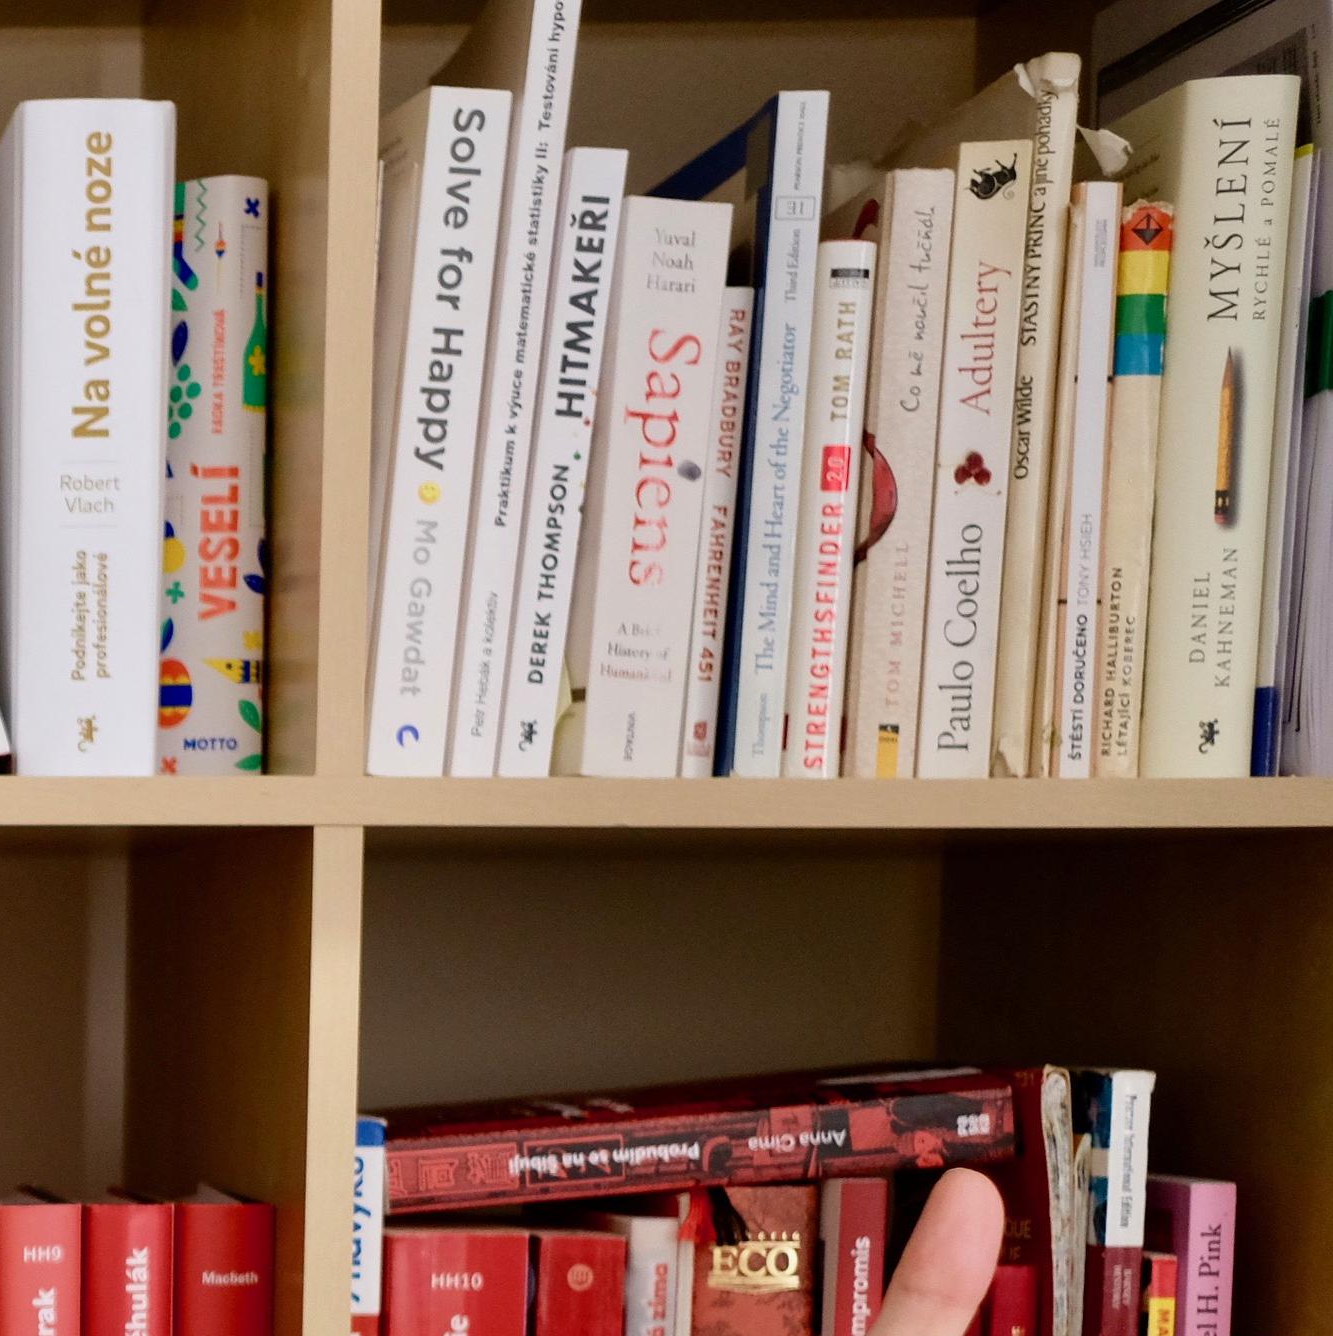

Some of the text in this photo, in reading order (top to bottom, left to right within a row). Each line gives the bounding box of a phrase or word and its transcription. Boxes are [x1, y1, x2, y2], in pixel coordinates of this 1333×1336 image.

[651, 251, 694, 271] Noah
[653, 227, 697, 249] Yuval
[1203, 116, 1253, 322] MYŠLENÍ
[1252, 116, 1281, 321] RYCHLÉ a POMALÉ
[72, 130, 114, 441] Na volné noze
[555, 195, 611, 418] HITMAKEŘI
[646, 275, 697, 294] Harari
[399, 105, 486, 697] Solve for Happy Mo Gawdat
[59, 473, 120, 492] Robert
[624, 328, 702, 587] Sapiens
[65, 496, 115, 514] Vlach
[191, 462, 240, 622] VESELÍ
[937, 260, 1012, 752] Paulo Coelho Adultery
[527, 463, 571, 685] DEREK THOMPSON
[1188, 571, 1211, 664] DANIEL
[1214, 546, 1240, 688] KAHNEMAN
[804, 501, 845, 770] STRENGTHSFINDER
[1101, 566, 1123, 757] RICHARD HALLIBURTON
[183, 737, 238, 751] MOTTO
[23, 1246, 62, 1263] HH9
[201, 1270, 259, 1288] Macbeth
[431, 1273, 484, 1291] HH10
[712, 1245, 800, 1277] ECO
[1198, 1222, 1223, 1280] Pink
[1196, 1286, 1219, 1314] H.
